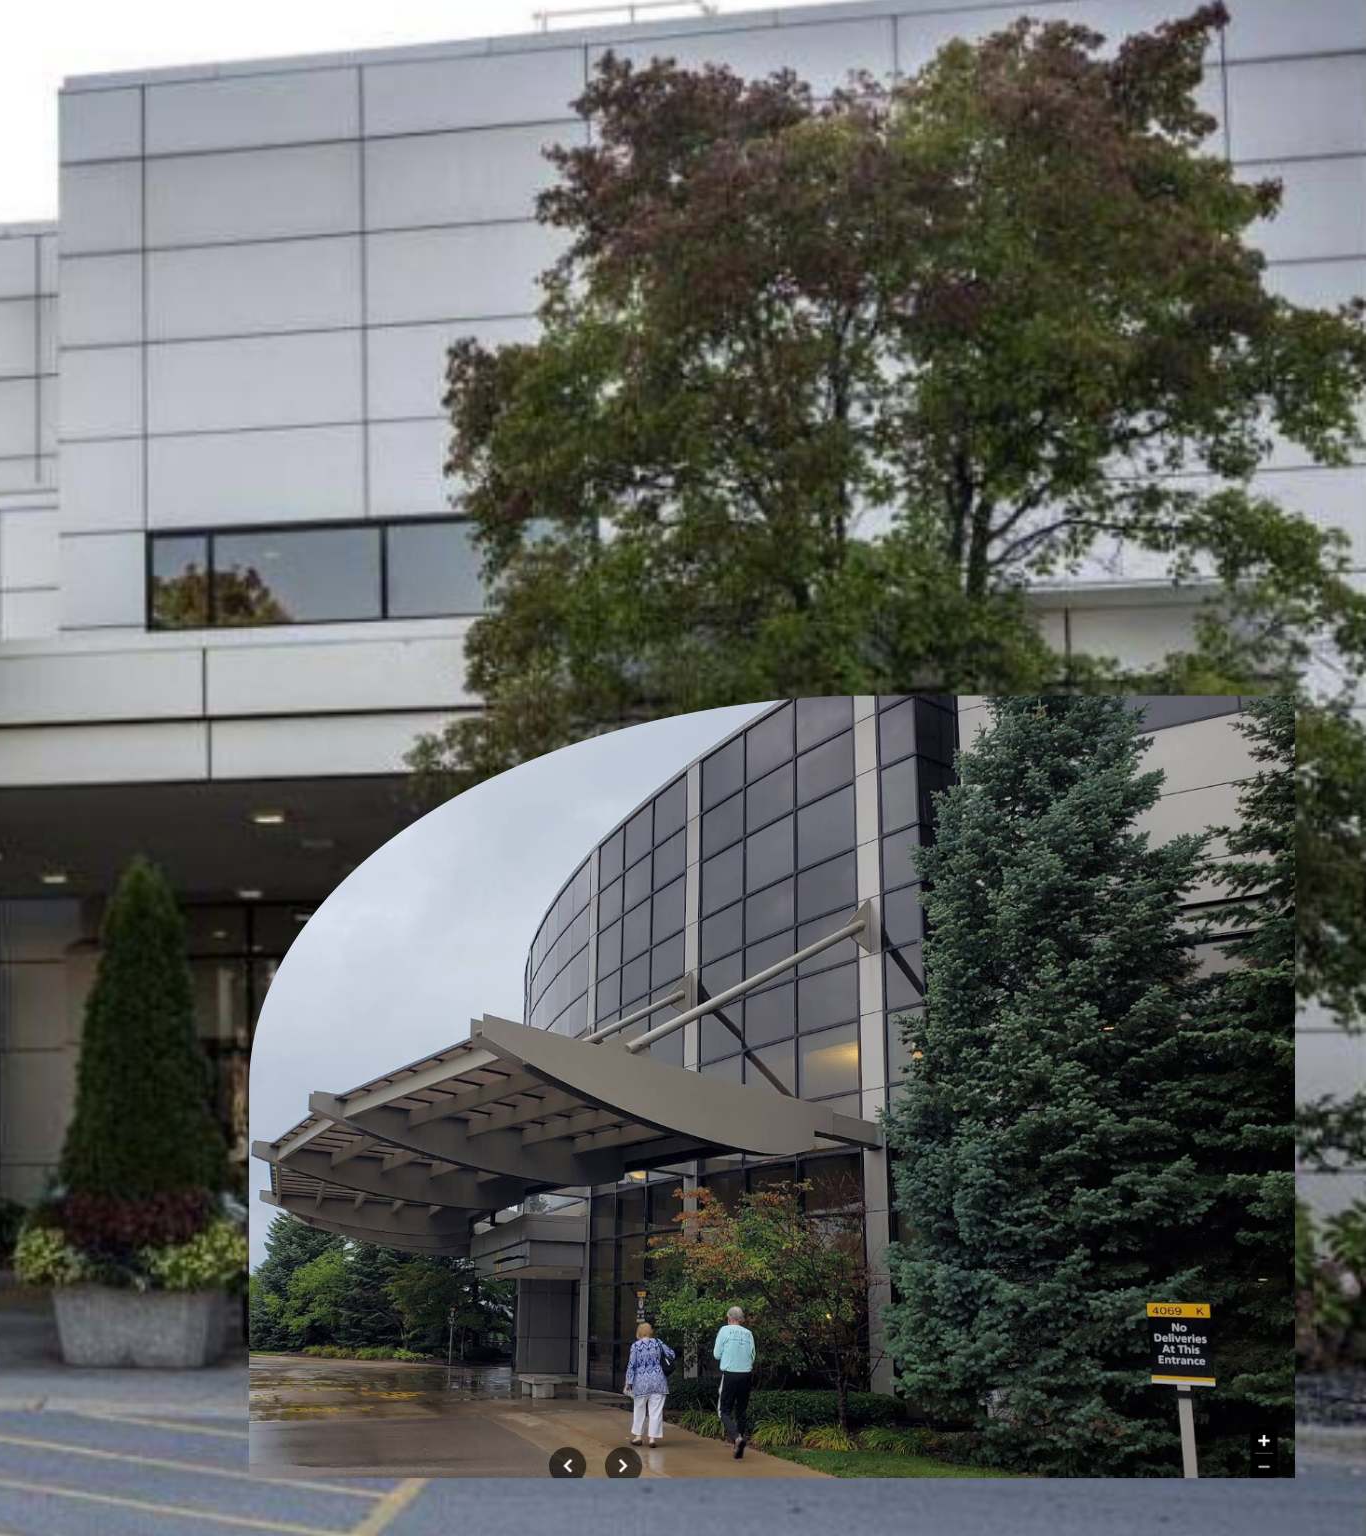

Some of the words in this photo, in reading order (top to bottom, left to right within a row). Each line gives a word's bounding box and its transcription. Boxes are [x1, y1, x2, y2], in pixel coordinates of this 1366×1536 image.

[1171, 1322, 1188, 1332] No
[1153, 1333, 1208, 1344] Deliveries
[1162, 1344, 1176, 1354] At
[1176, 1344, 1201, 1355] This
[1157, 1354, 1206, 1366] Entrance
